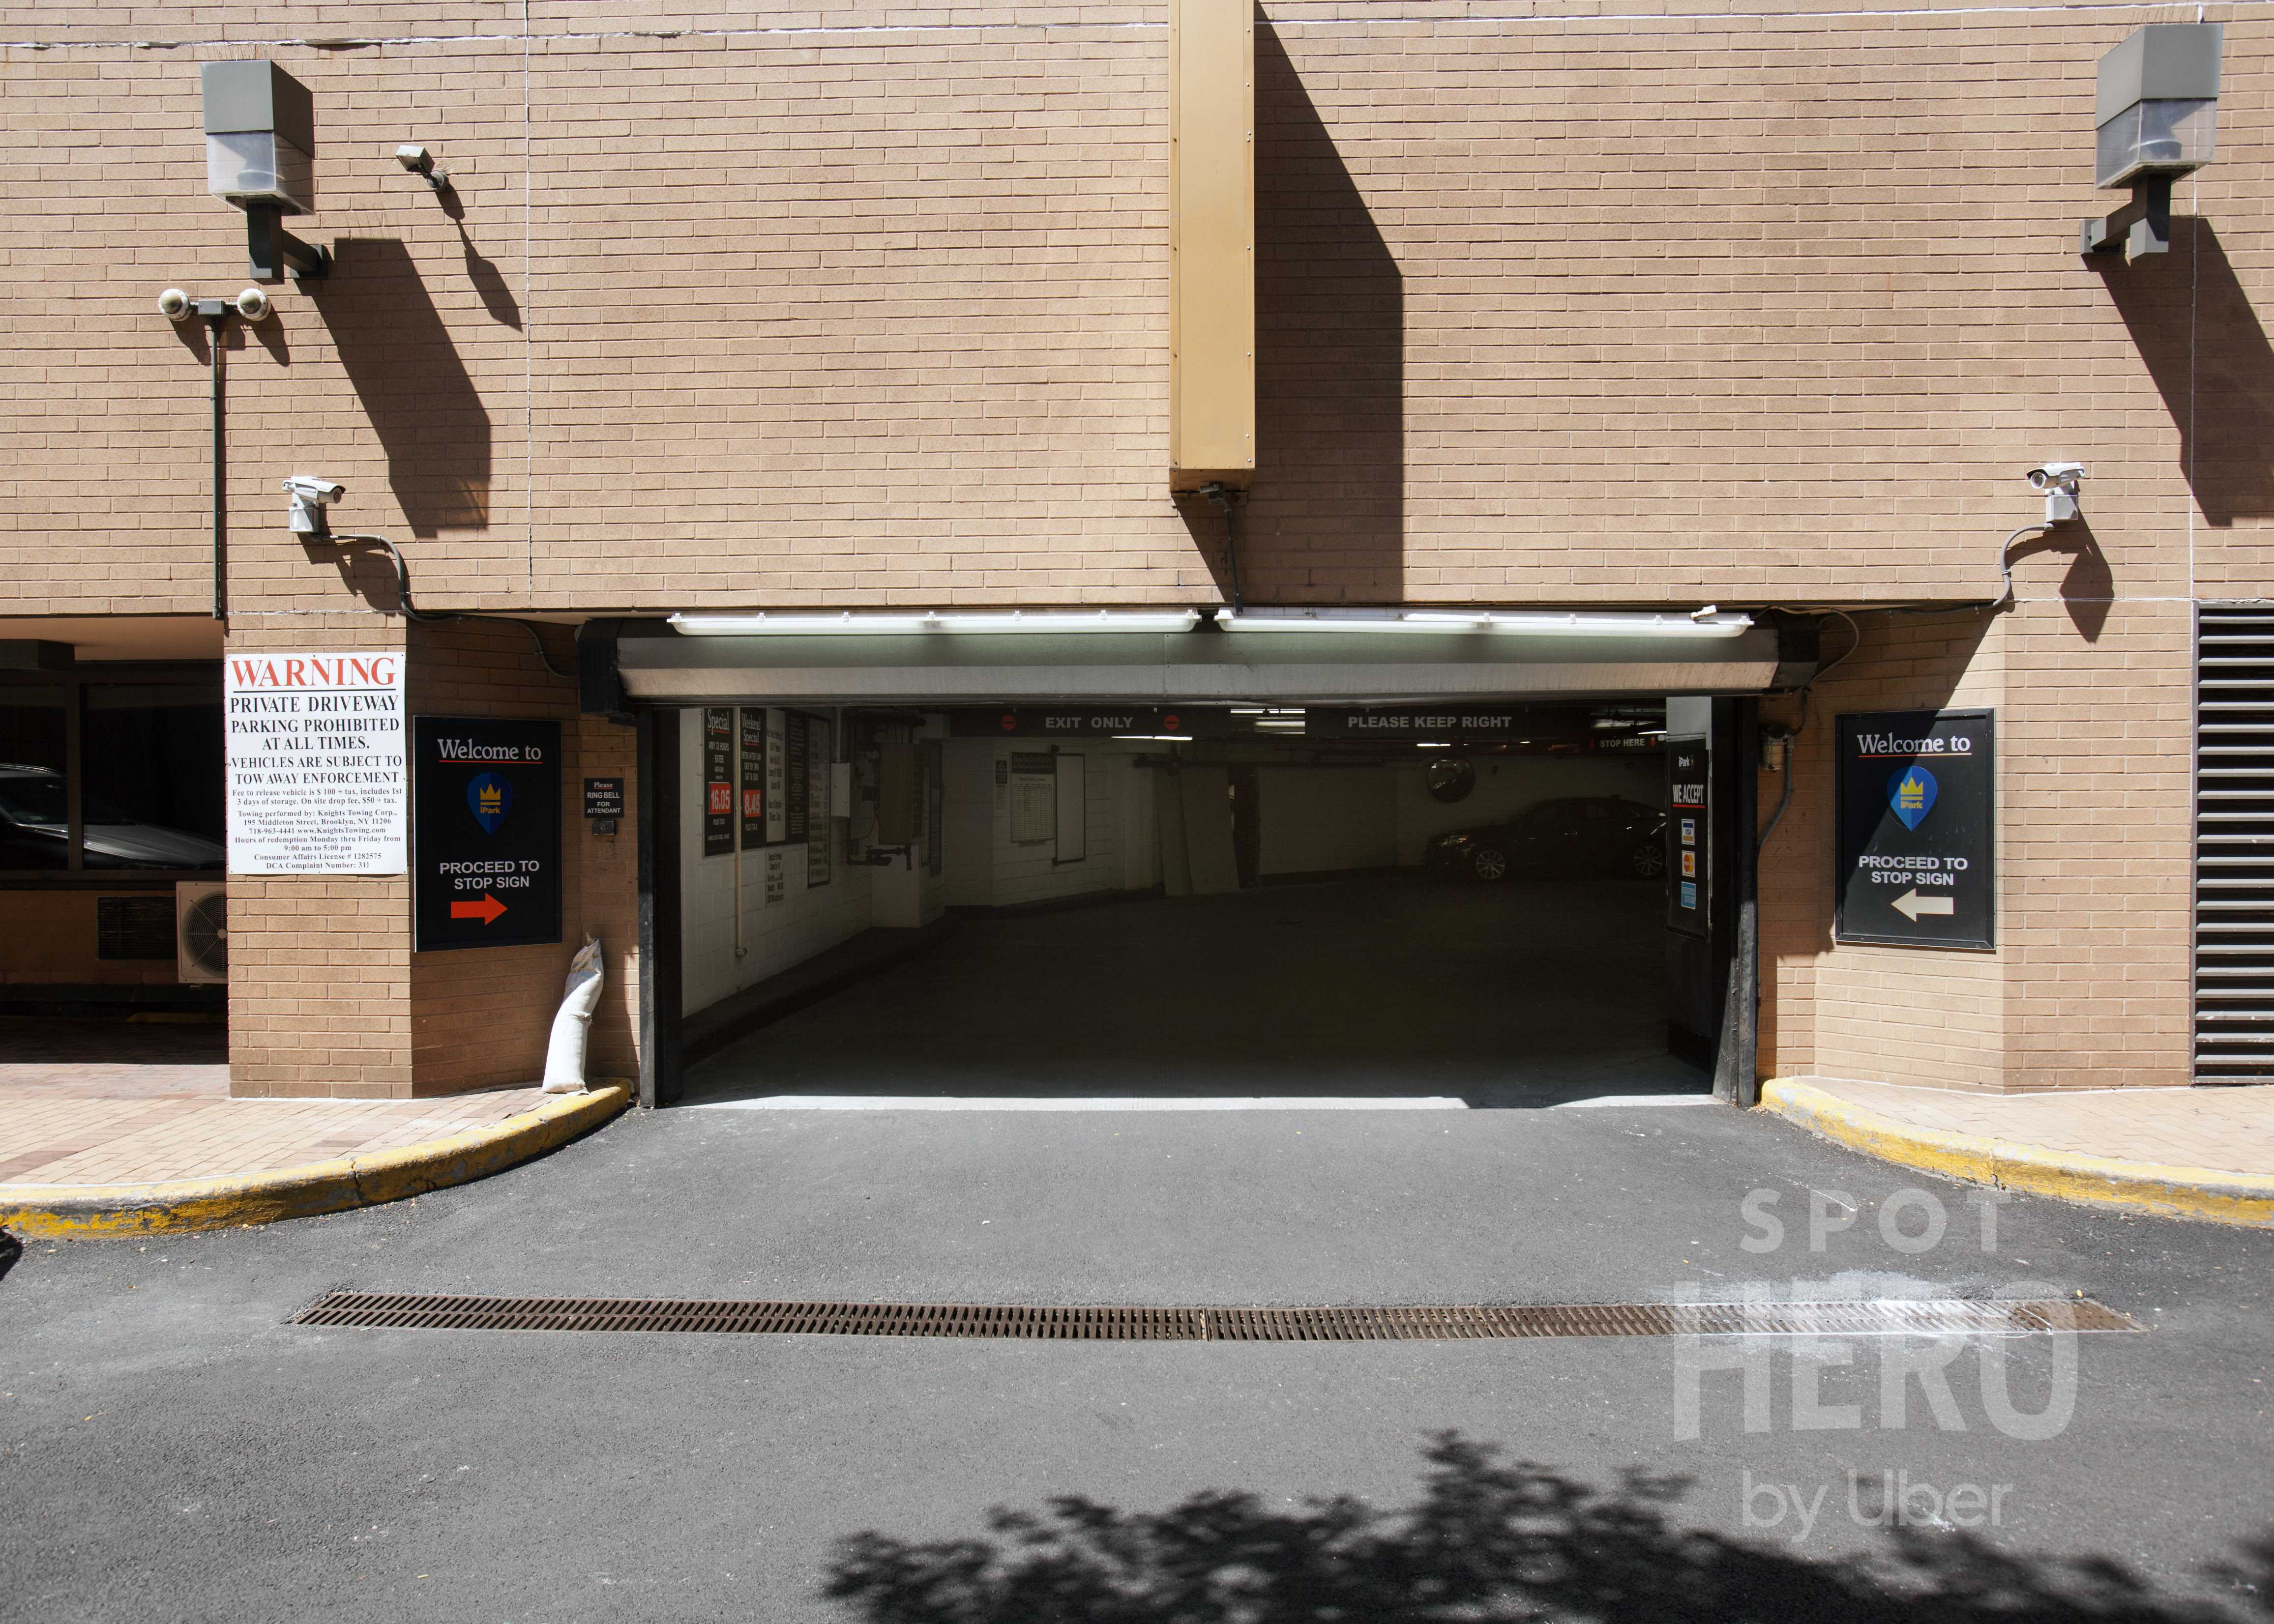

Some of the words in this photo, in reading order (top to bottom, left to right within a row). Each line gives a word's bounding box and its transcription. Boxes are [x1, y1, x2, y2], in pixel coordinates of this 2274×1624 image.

[231, 657, 396, 688] WARNING
[231, 696, 300, 713] PRIVATE
[308, 695, 399, 711] DRIVEWAY
[232, 719, 299, 733] PARKING
[304, 718, 400, 732] PROHIBITED
[708, 709, 729, 735] Special
[741, 713, 761, 730] Weekend
[1045, 717, 1081, 728] EXIT
[1091, 717, 1133, 728] ONLY
[1348, 716, 1409, 728] PLEASE
[1415, 716, 1456, 728] KEEP
[1462, 716, 1511, 728] RIGHT
[262, 737, 281, 750] AT
[284, 737, 314, 750] ALL
[318, 735, 370, 750] TIMES.
[743, 729, 759, 745] Special
[1623, 738, 1645, 747] HERE
[1857, 732, 1944, 754] Welcome
[1950, 736, 1971, 752] to
[438, 738, 519, 760] Welcome
[525, 745, 541, 760] to
[232, 757, 294, 768] VEHICLES
[298, 756, 323, 768] ARE
[326, 755, 382, 767] SUBJECT
[384, 755, 402, 766] TO
[1678, 756, 1690, 767] iPark
[235, 773, 265, 784] TOW
[266, 773, 298, 784] AWAY
[303, 772, 399, 784] ENFORCEMENT
[711, 789, 730, 811] 16.05
[1673, 784, 1682, 803] WE
[1683, 784, 1704, 804] ACCEPT
[243, 798, 260, 807] days
[328, 797, 345, 806] drop
[745, 794, 761, 814] 8.45
[297, 827, 385, 835] www.KnightsTowing.com
[440, 861, 515, 874] PROCEED
[519, 860, 540, 872] TO
[1859, 856, 1939, 870] PROCEED
[1943, 857, 1968, 870] TO
[454, 877, 492, 890] STOP
[497, 876, 530, 888] SIGN
[1871, 871, 1912, 884] STOP
[1916, 872, 1954, 885] SIGN
